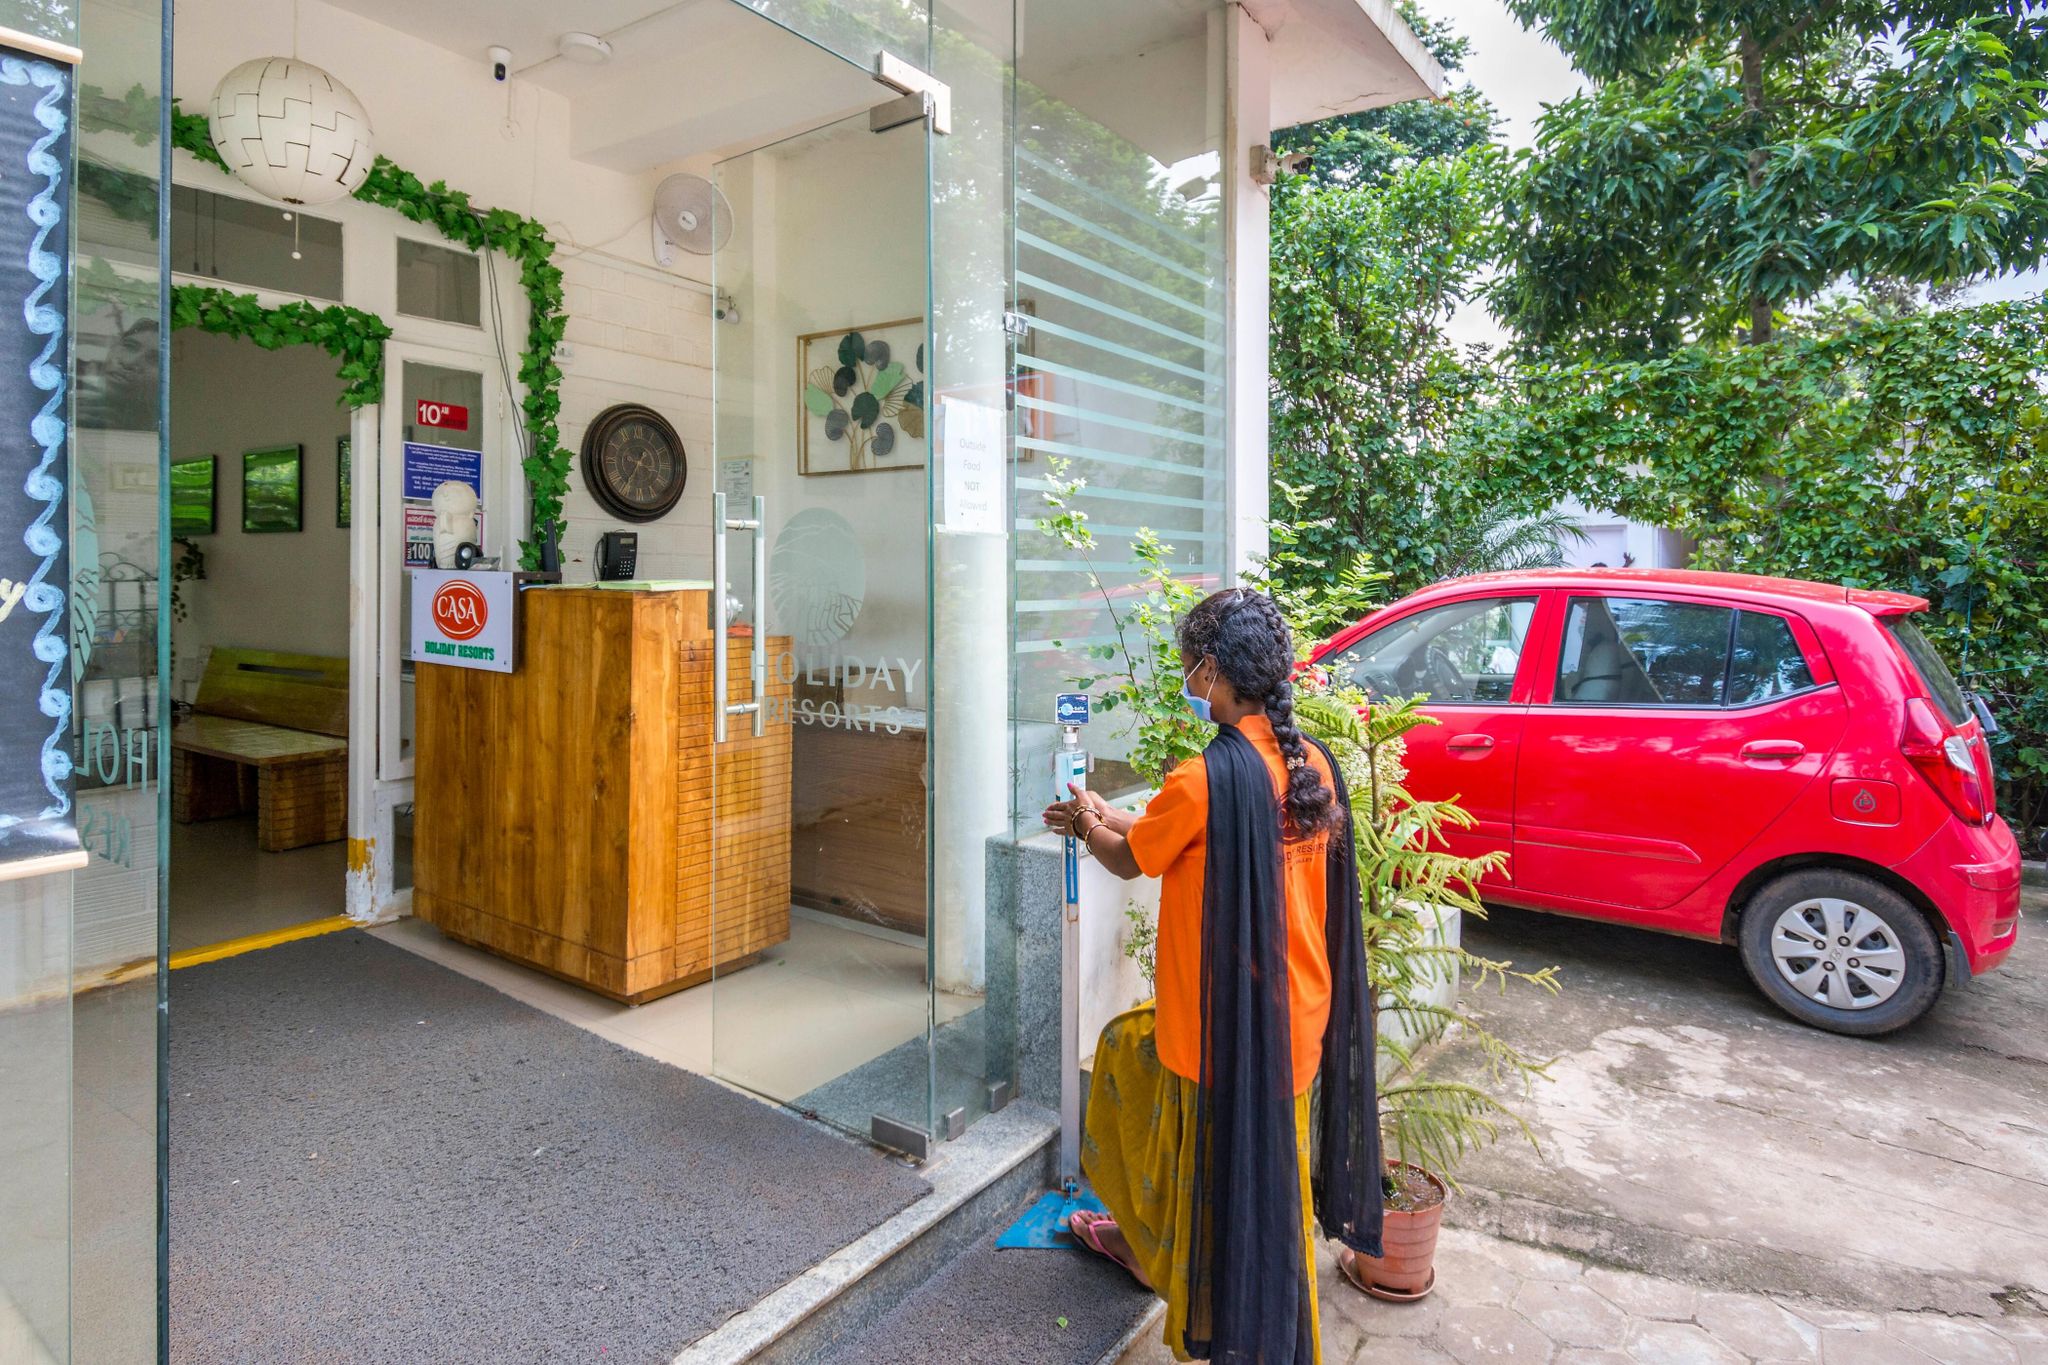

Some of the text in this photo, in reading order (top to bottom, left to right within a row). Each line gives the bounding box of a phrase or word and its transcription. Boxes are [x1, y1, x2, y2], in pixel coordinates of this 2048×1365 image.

[419, 403, 441, 425] 10
[959, 438, 986, 452] Outside
[963, 459, 981, 471] Food
[964, 481, 980, 492] NOT
[412, 543, 431, 560] 100
[437, 595, 481, 627] CASA
[424, 640, 495, 661] HOLIDAY RESORTS
[765, 696, 902, 736] RESORTS
